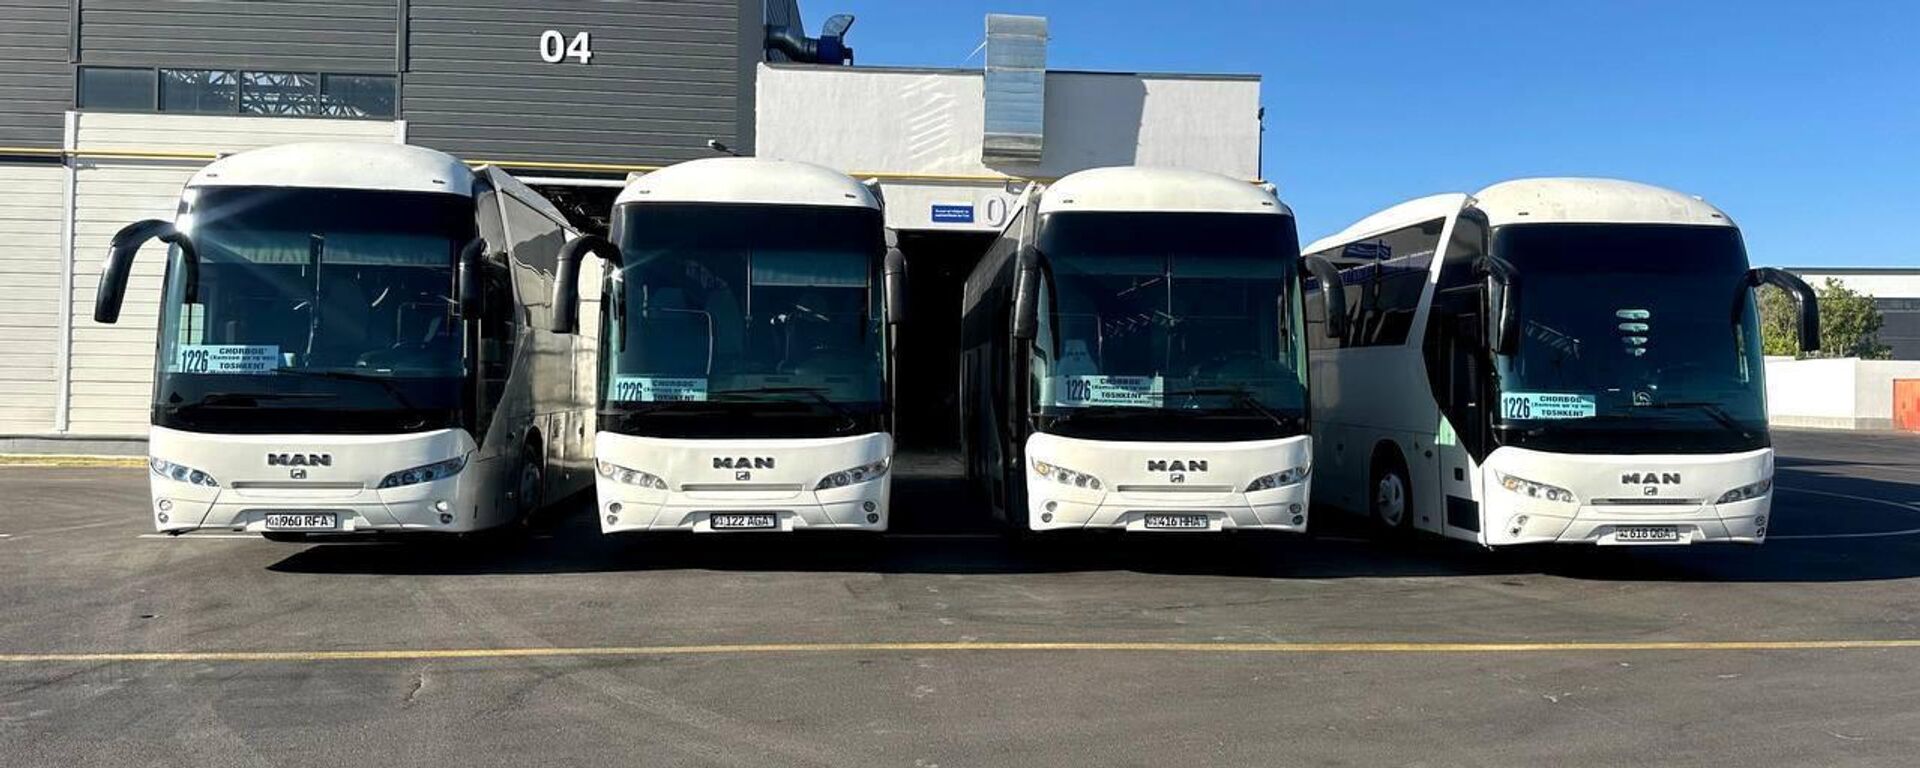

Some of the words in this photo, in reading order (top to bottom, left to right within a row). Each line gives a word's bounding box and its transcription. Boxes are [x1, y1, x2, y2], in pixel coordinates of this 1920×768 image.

[540, 29, 592, 65] 04
[182, 349, 209, 373] 1226
[616, 381, 643, 401] 1226
[1066, 379, 1092, 402] 1226
[1503, 397, 1530, 419] 1226
[267, 453, 332, 467] MAN
[713, 457, 775, 469] MAN
[1147, 460, 1208, 472] MAN
[1621, 472, 1681, 485] MAN
[281, 515, 302, 526] 960
[304, 515, 329, 526] RFA
